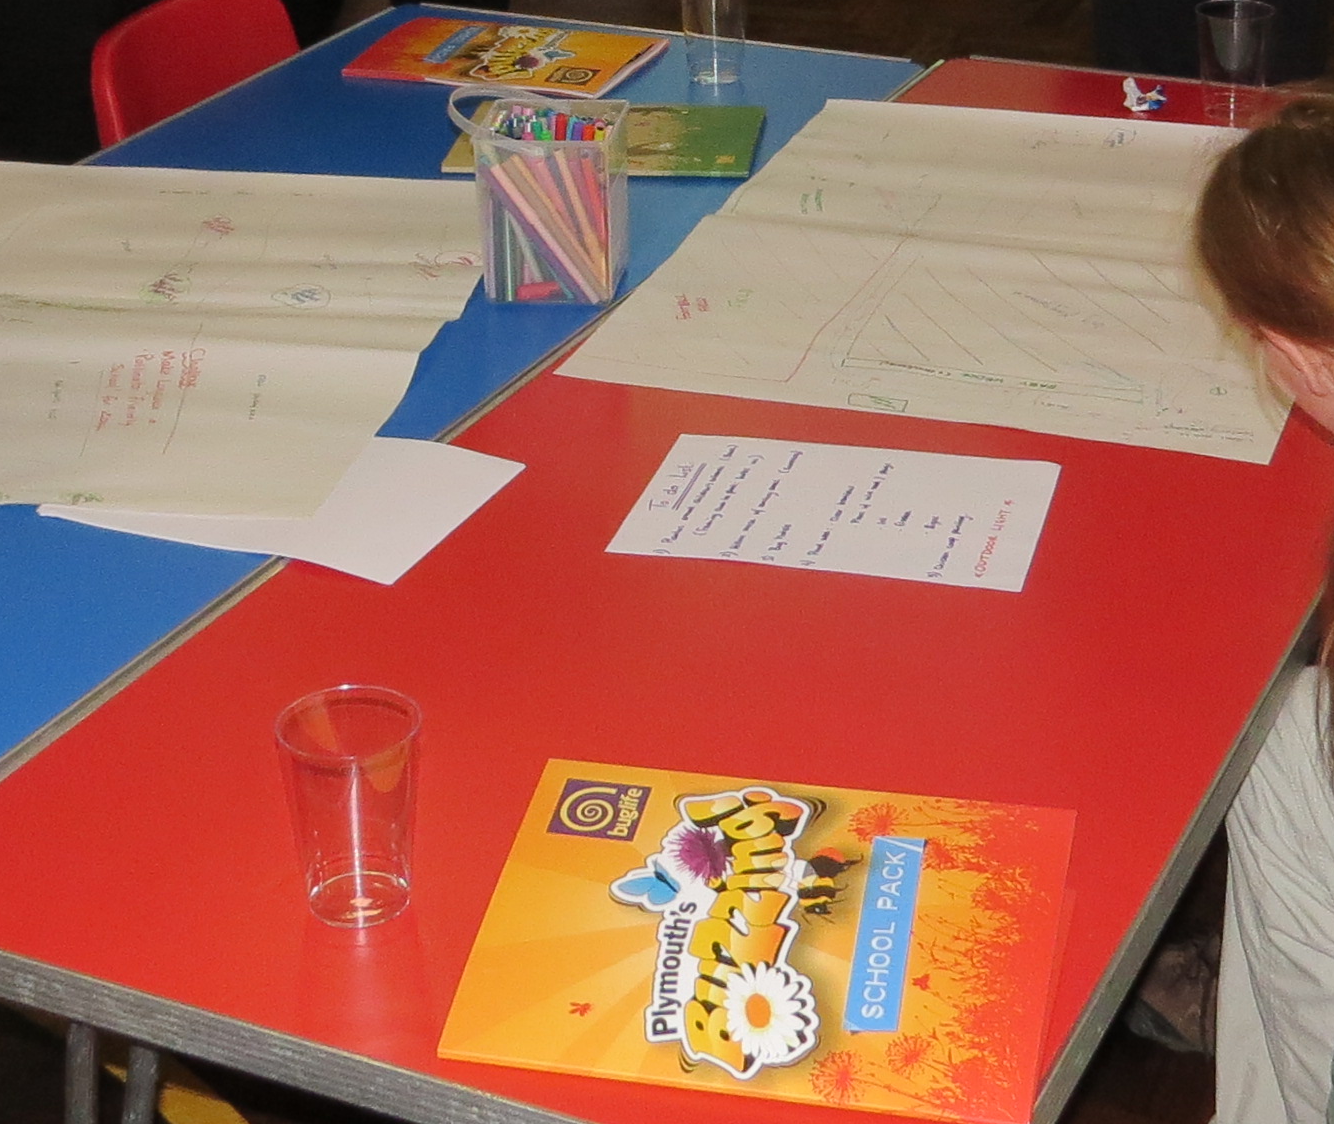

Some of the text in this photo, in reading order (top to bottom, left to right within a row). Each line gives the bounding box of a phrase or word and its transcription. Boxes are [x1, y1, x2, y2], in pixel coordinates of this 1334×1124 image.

[648, 499, 670, 511] To
[663, 484, 679, 496] do
[607, 787, 644, 838] buglife
[651, 901, 698, 1037] Plymouth's
[860, 851, 907, 1020] SCHOOL PACK
